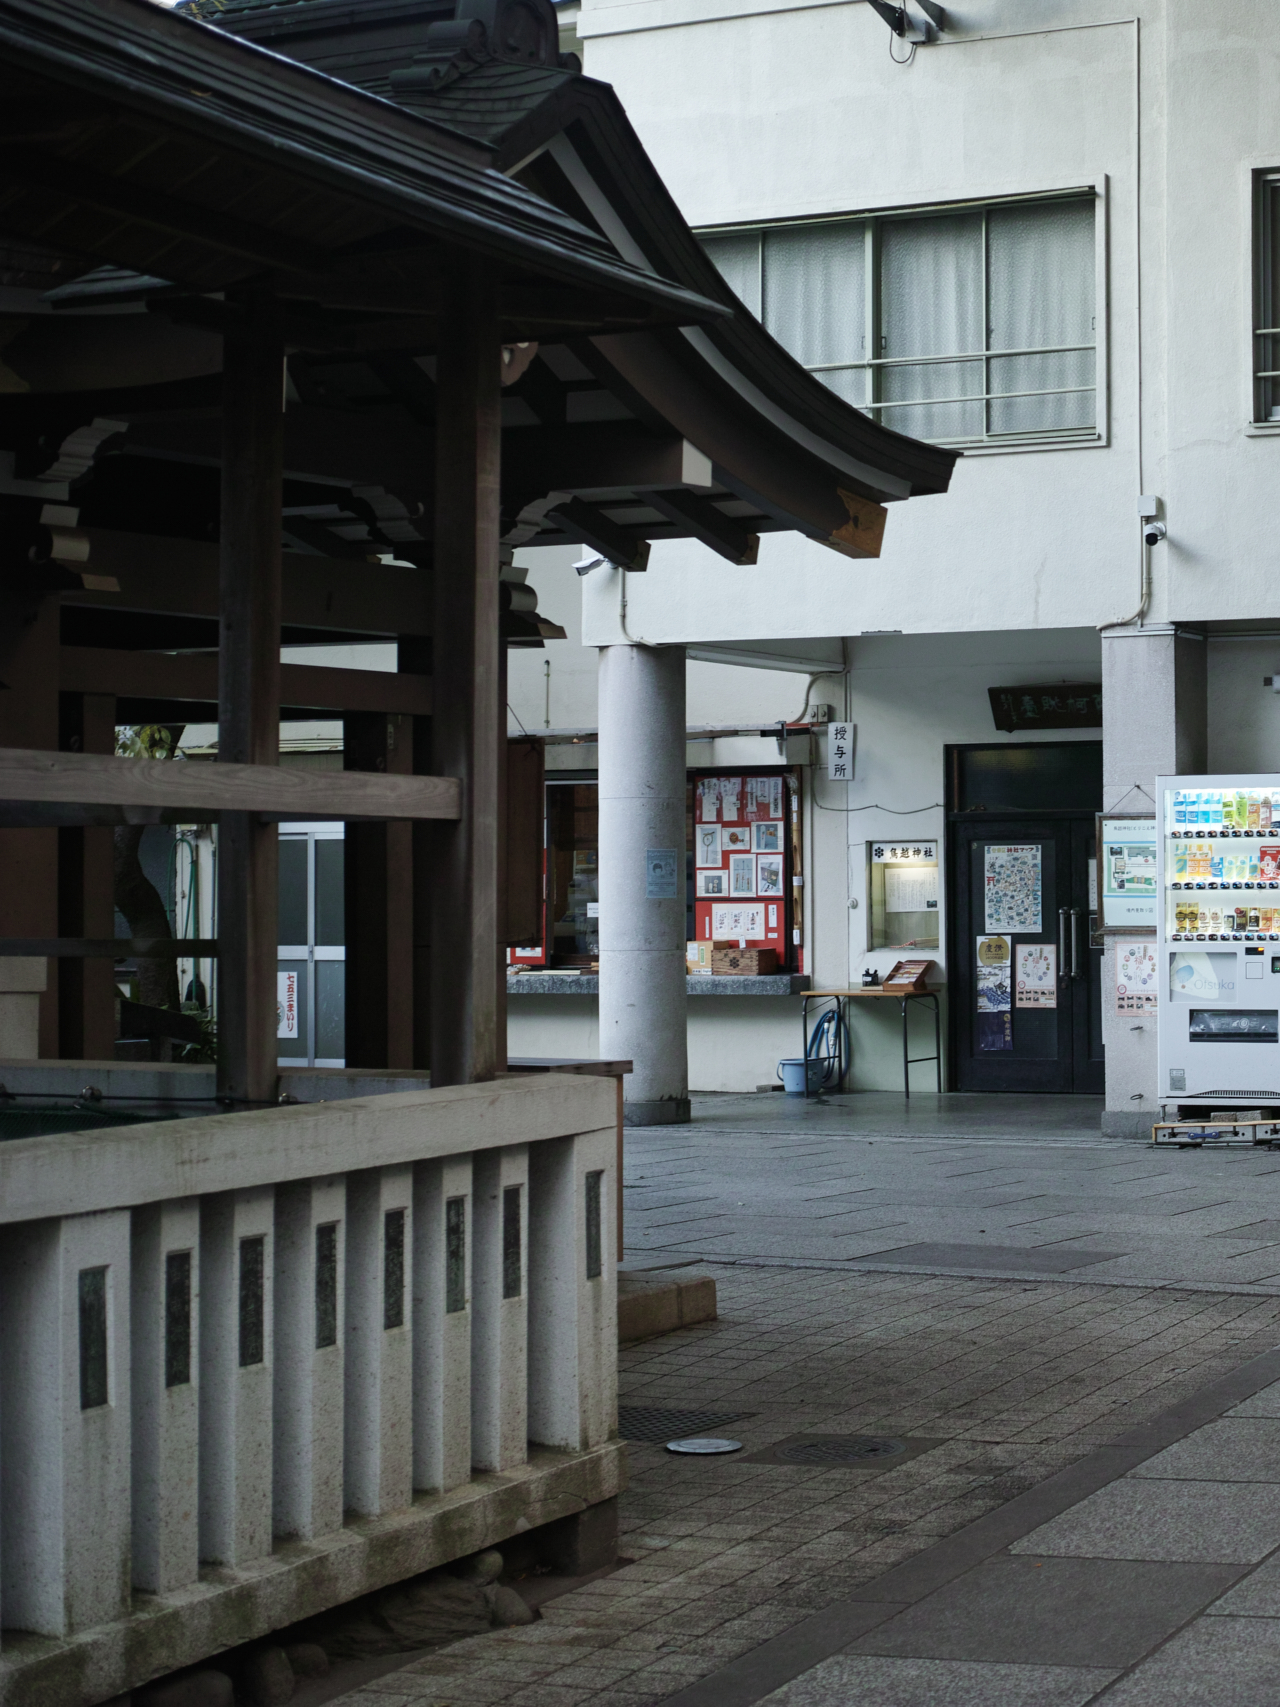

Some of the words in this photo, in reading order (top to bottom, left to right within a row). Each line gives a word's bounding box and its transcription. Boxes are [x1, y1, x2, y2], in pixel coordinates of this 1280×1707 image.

[834, 726, 848, 778] 授与所
[889, 847, 934, 860] 鳥越神社
[1194, 978, 1235, 991] Otsuka
[286, 973, 295, 1032] 七五三まいり
